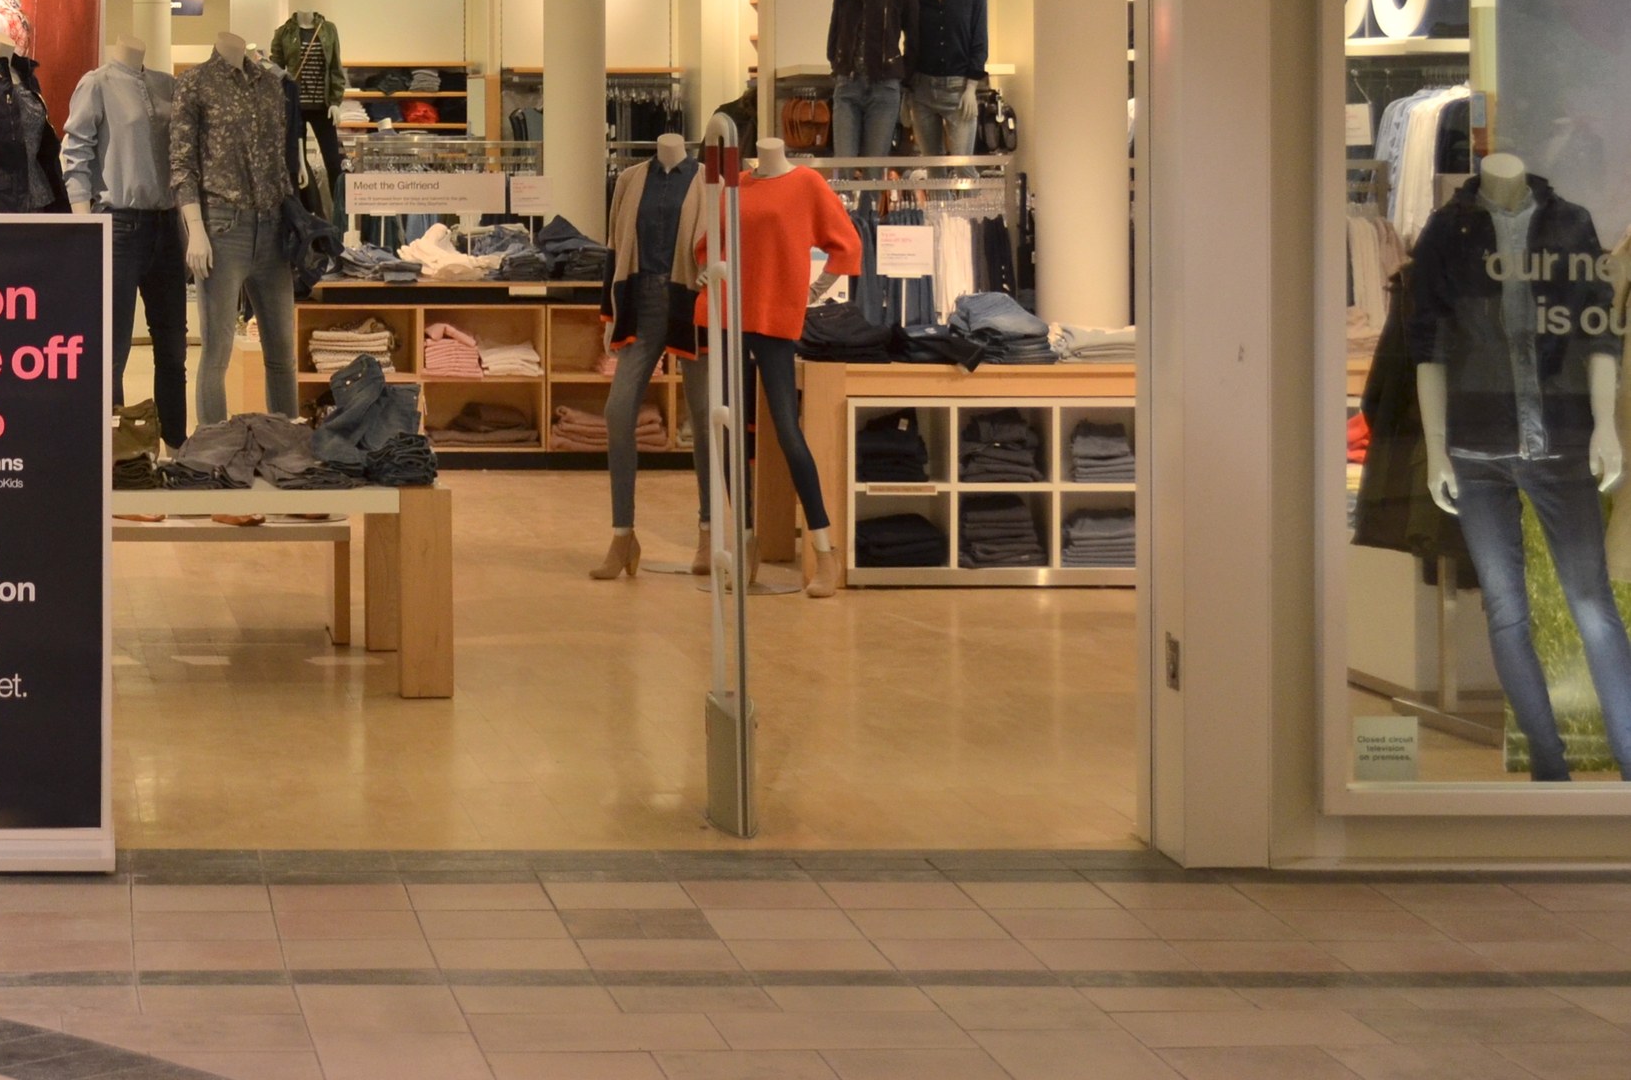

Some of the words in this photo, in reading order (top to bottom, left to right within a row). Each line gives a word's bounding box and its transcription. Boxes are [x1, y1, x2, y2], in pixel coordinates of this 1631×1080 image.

[354, 181, 377, 190] Meet
[380, 181, 395, 190] the
[397, 181, 440, 190] Girlfriend
[1485, 252, 1559, 281] our
[1569, 253, 1631, 282] ne
[1536, 296, 1571, 335] is
[11, 335, 84, 380] off
[1356, 735, 1385, 743] Closed
[1388, 735, 1413, 743] circuit
[1366, 744, 1405, 752] television
